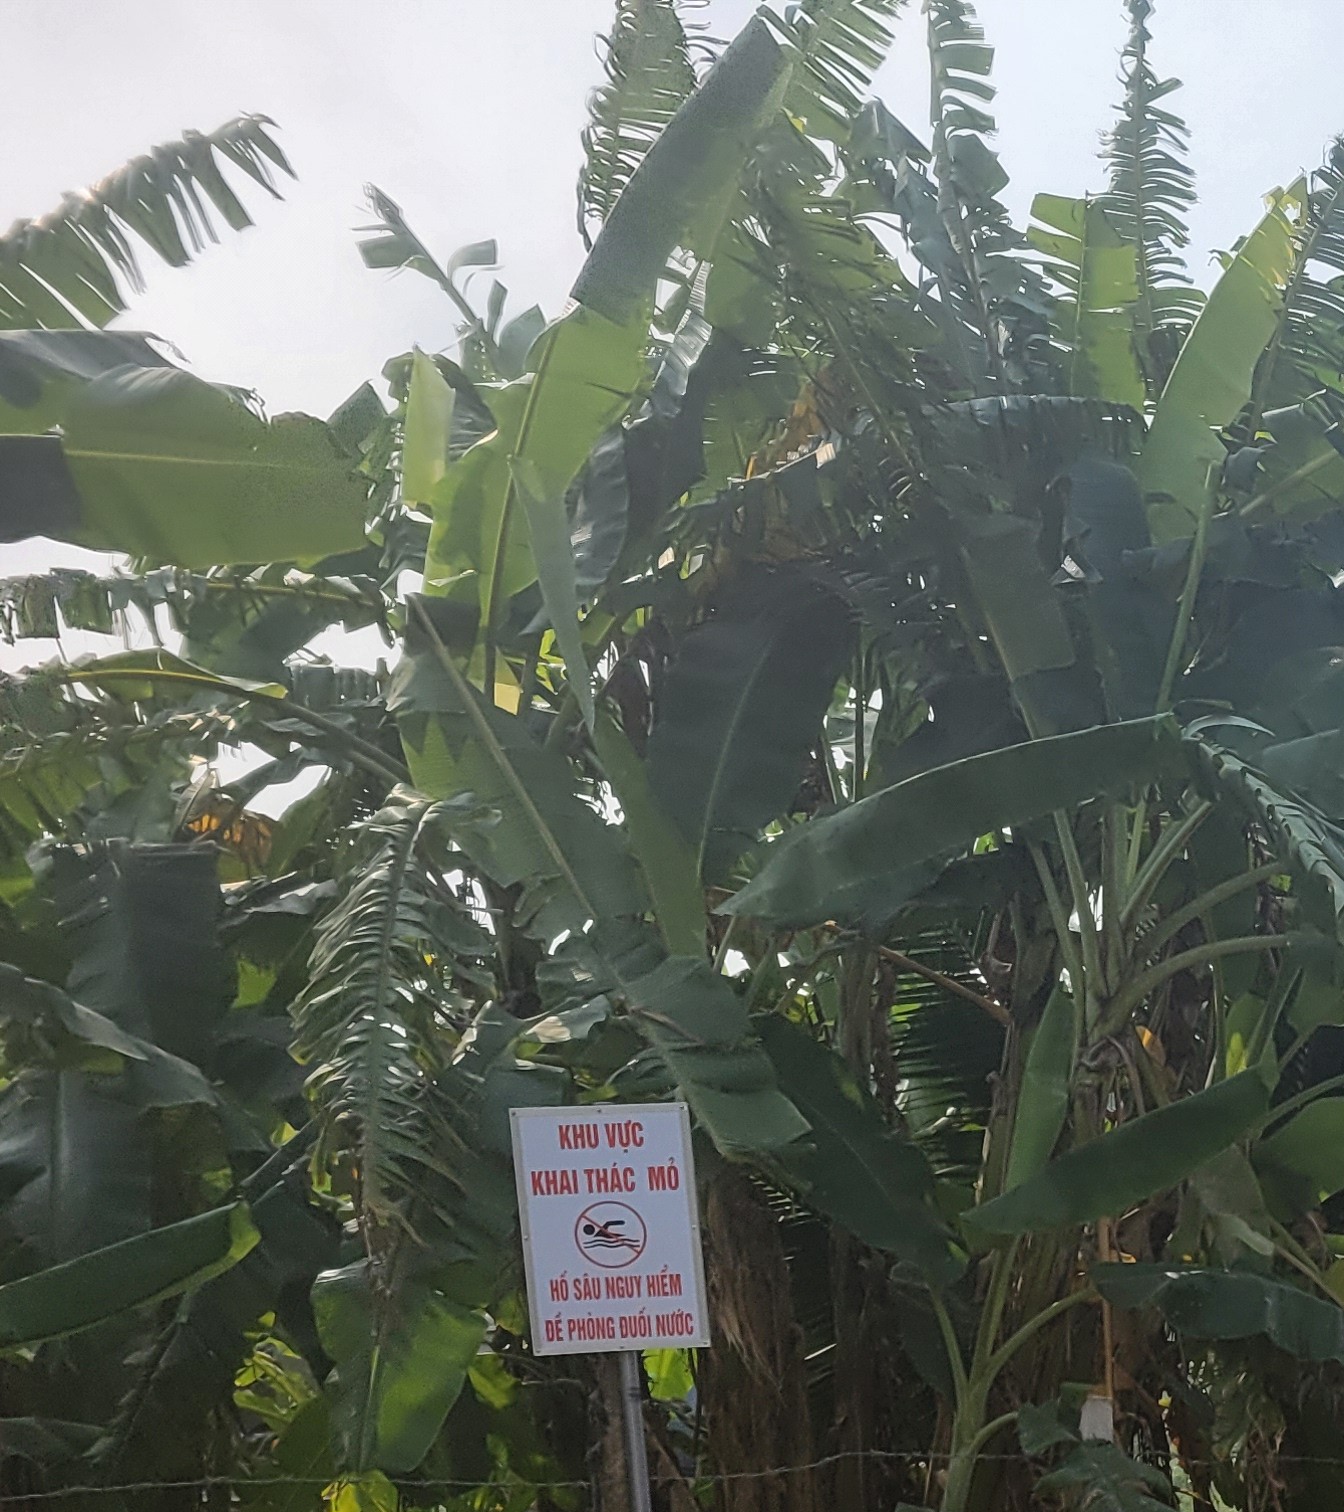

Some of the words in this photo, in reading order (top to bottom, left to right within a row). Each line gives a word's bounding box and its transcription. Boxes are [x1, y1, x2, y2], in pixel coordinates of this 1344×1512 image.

[558, 1123, 600, 1150] KHU
[604, 1119, 645, 1153] VỰC
[531, 1169, 579, 1196] KHAI
[584, 1162, 636, 1193] THÁC
[647, 1156, 680, 1191] MỎ
[549, 1269, 569, 1301] HỐ
[573, 1272, 601, 1301] SÂU
[605, 1275, 642, 1299] NGUY
[646, 1263, 683, 1298] HIỂM
[567, 1311, 616, 1341] PHÒNG
[619, 1306, 652, 1339] ĐUỐI
[655, 1308, 694, 1338] NƯỚC
